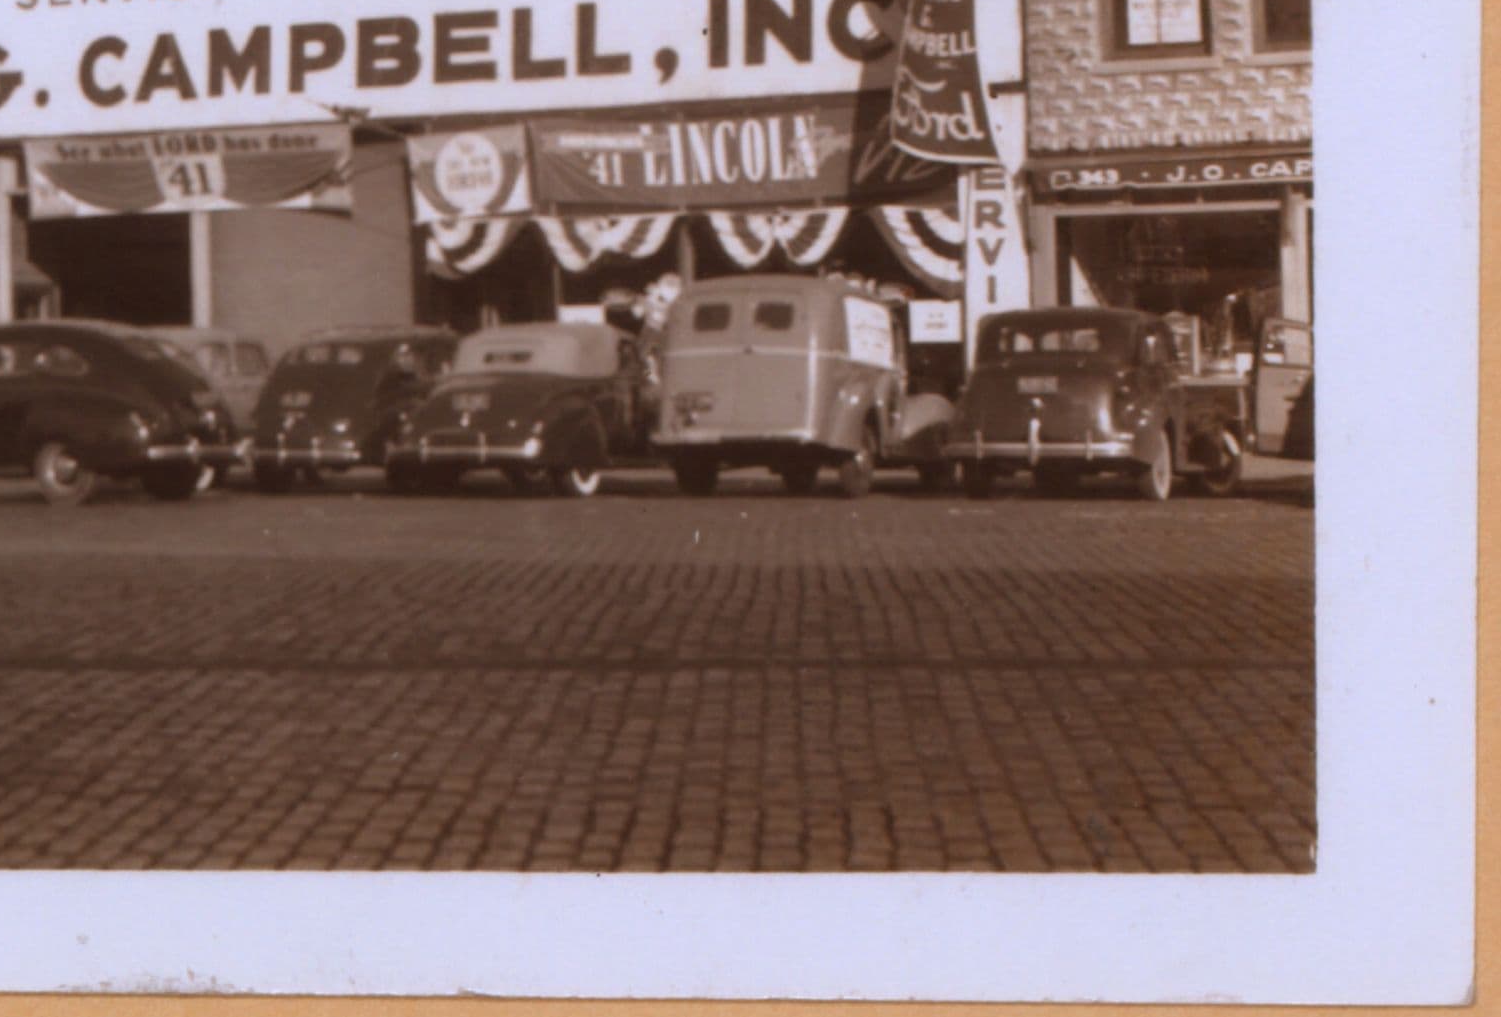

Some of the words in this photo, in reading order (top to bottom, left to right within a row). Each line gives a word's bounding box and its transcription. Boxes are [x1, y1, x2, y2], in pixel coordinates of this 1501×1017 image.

[77, 2, 680, 108] CAMPBELL,
[167, 161, 212, 197] 41
[639, 115, 819, 186] LINCOLN
